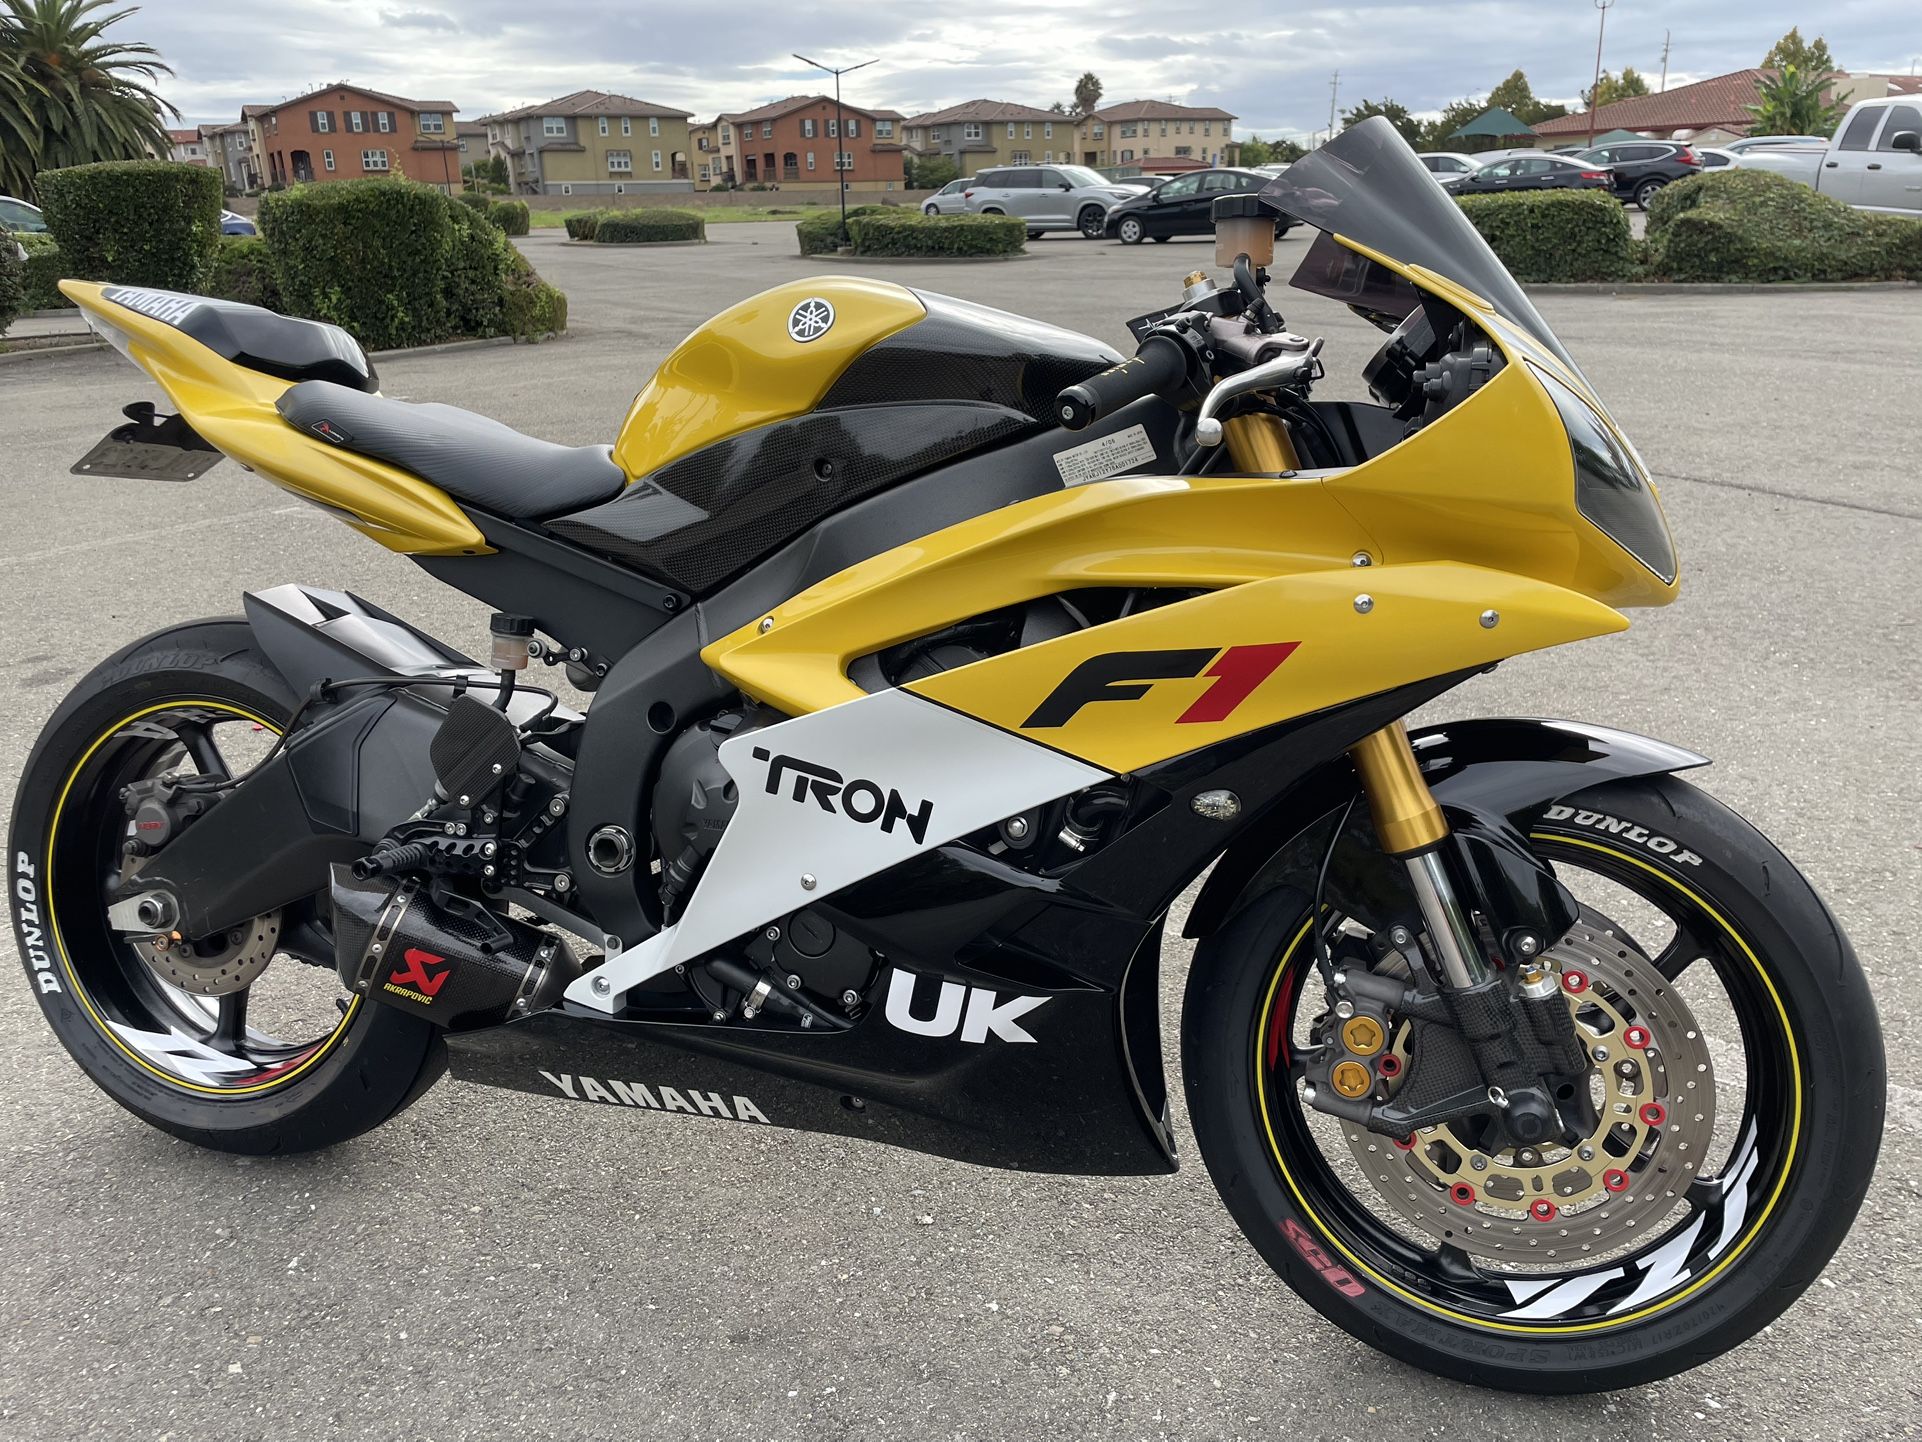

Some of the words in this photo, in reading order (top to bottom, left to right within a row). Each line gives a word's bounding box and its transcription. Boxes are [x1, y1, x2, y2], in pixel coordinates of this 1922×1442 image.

[1019, 641, 1302, 728] F1
[752, 746, 934, 845] TRON
[1543, 804, 1703, 866] DUNLOP
[16, 851, 62, 994] DUNLOP
[383, 982, 433, 1005] AKRAPOVIC
[885, 967, 1053, 1044] UK
[538, 1070, 771, 1124] YAMAHA
